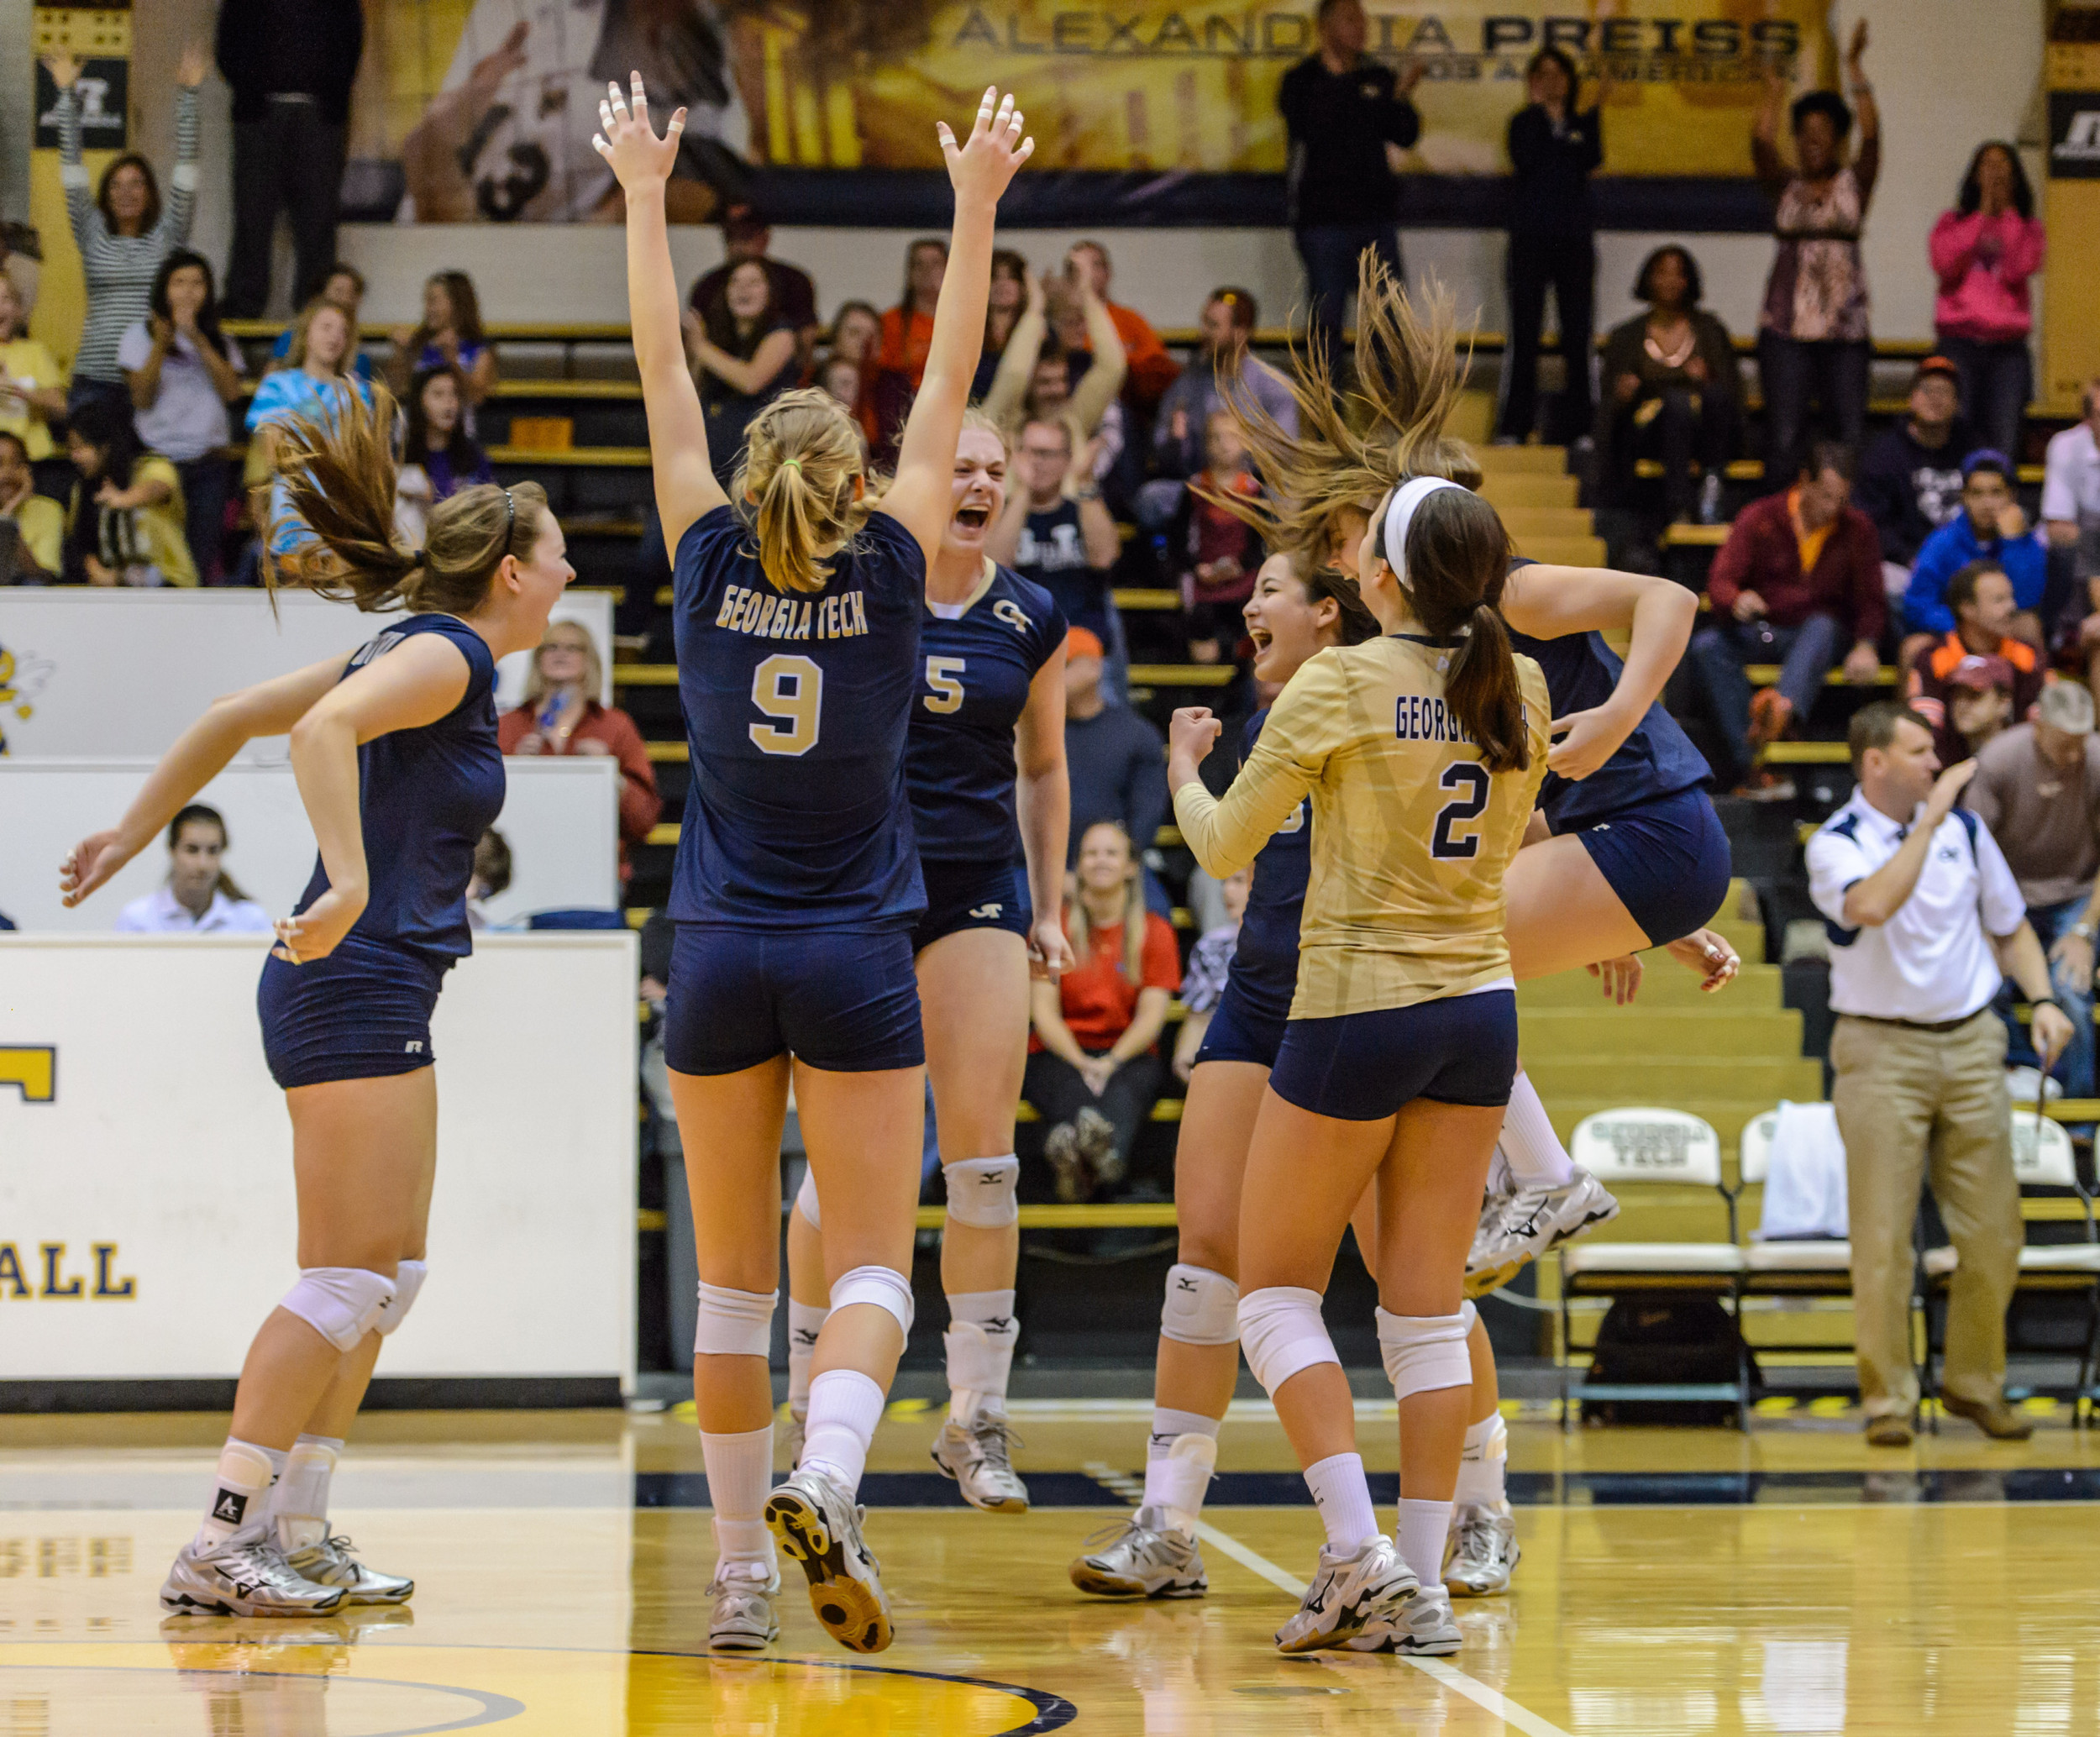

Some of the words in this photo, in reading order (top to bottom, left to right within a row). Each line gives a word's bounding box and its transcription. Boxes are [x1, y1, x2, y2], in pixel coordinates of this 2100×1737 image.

[953, 8, 1455, 56] ALEXANDIA
[1482, 14, 1801, 57] PREISS
[716, 585, 812, 640] GEORGIA
[817, 590, 869, 640] TECH
[748, 653, 823, 756] 9
[923, 655, 966, 715] 5
[1396, 695, 1479, 745] GEORG
[1430, 760, 1493, 861] 2
